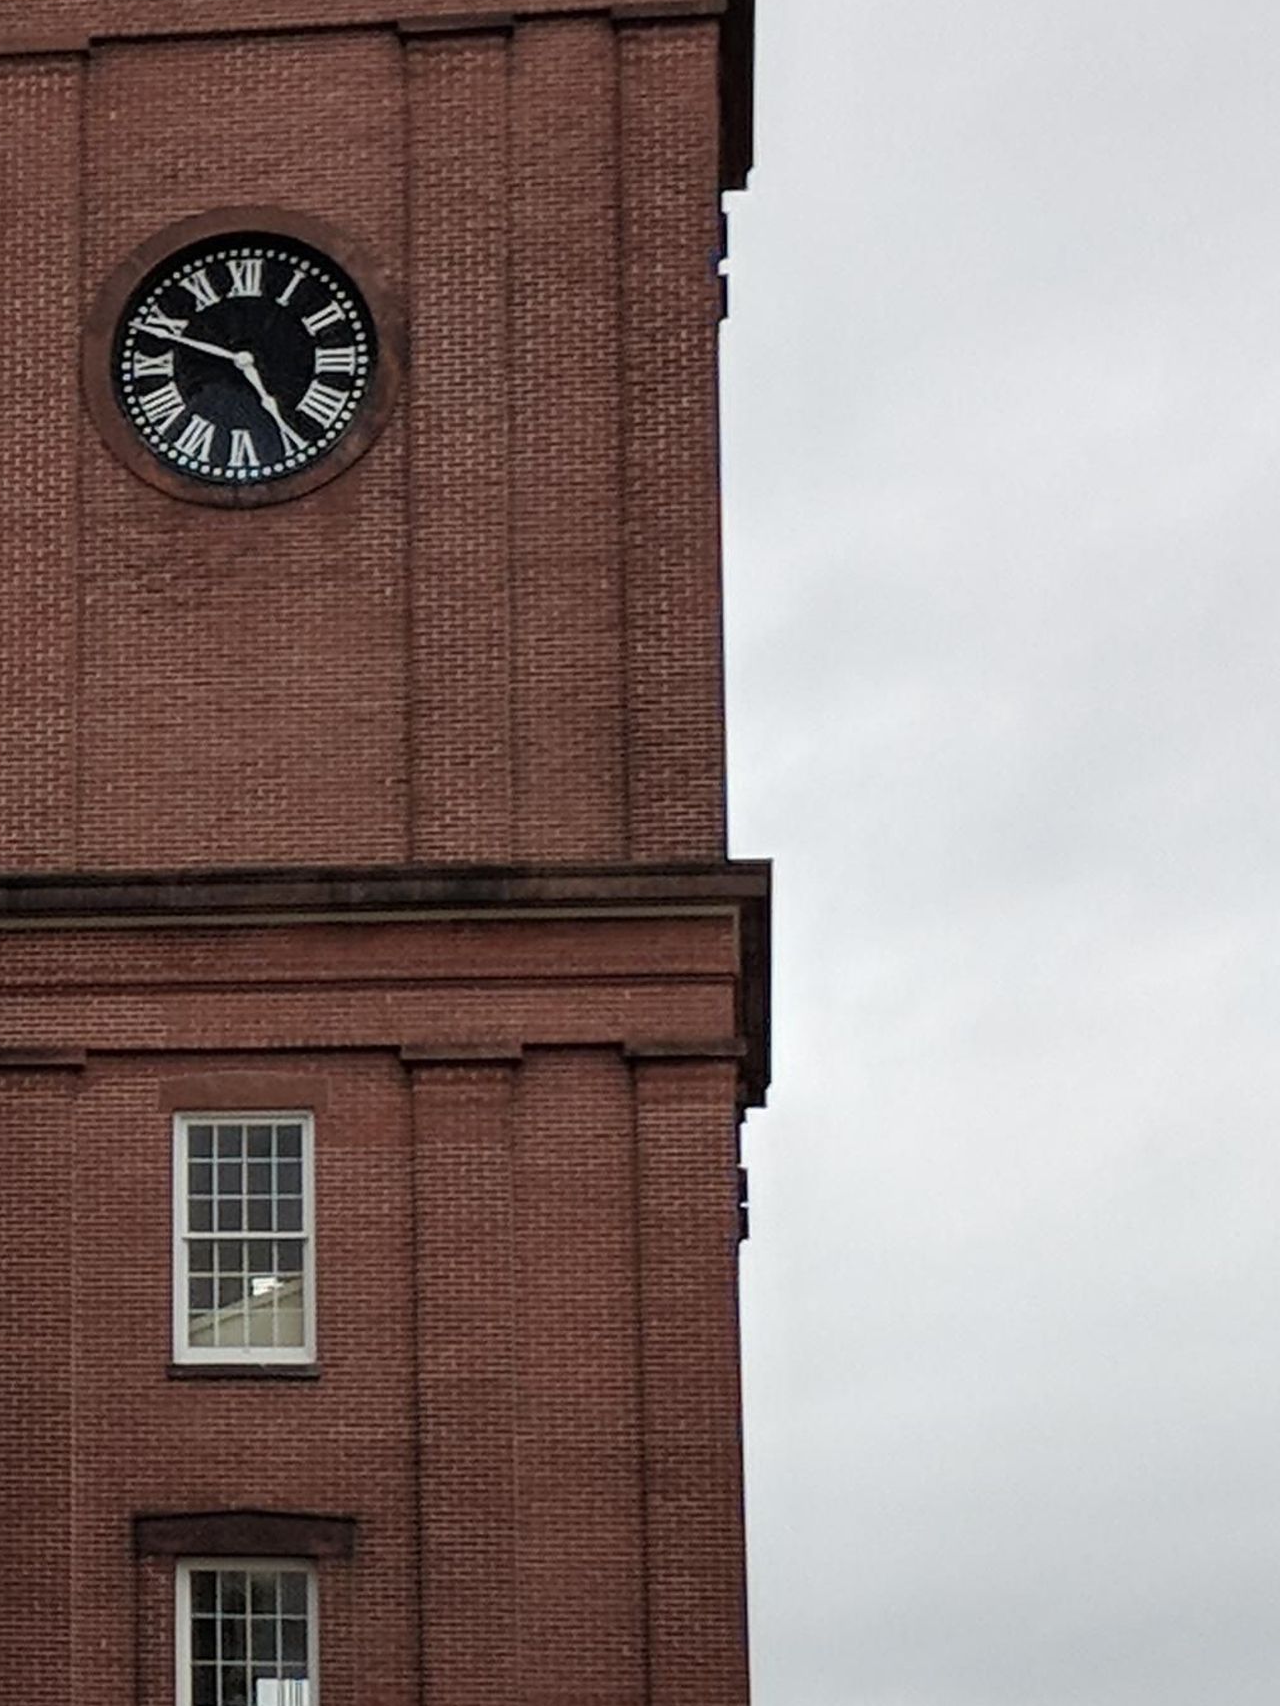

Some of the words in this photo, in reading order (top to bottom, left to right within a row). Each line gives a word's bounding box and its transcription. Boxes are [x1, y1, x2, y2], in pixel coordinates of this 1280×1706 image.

[178, 268, 222, 313] XI
[226, 258, 264, 299] XII
[274, 269, 307, 307] I
[301, 299, 346, 336] II
[133, 349, 174, 379] IX
[314, 345, 356, 376] III
[138, 380, 187, 436] VIII
[294, 379, 351, 431] IIII
[173, 413, 217, 464] VII
[227, 428, 261, 468] VI
